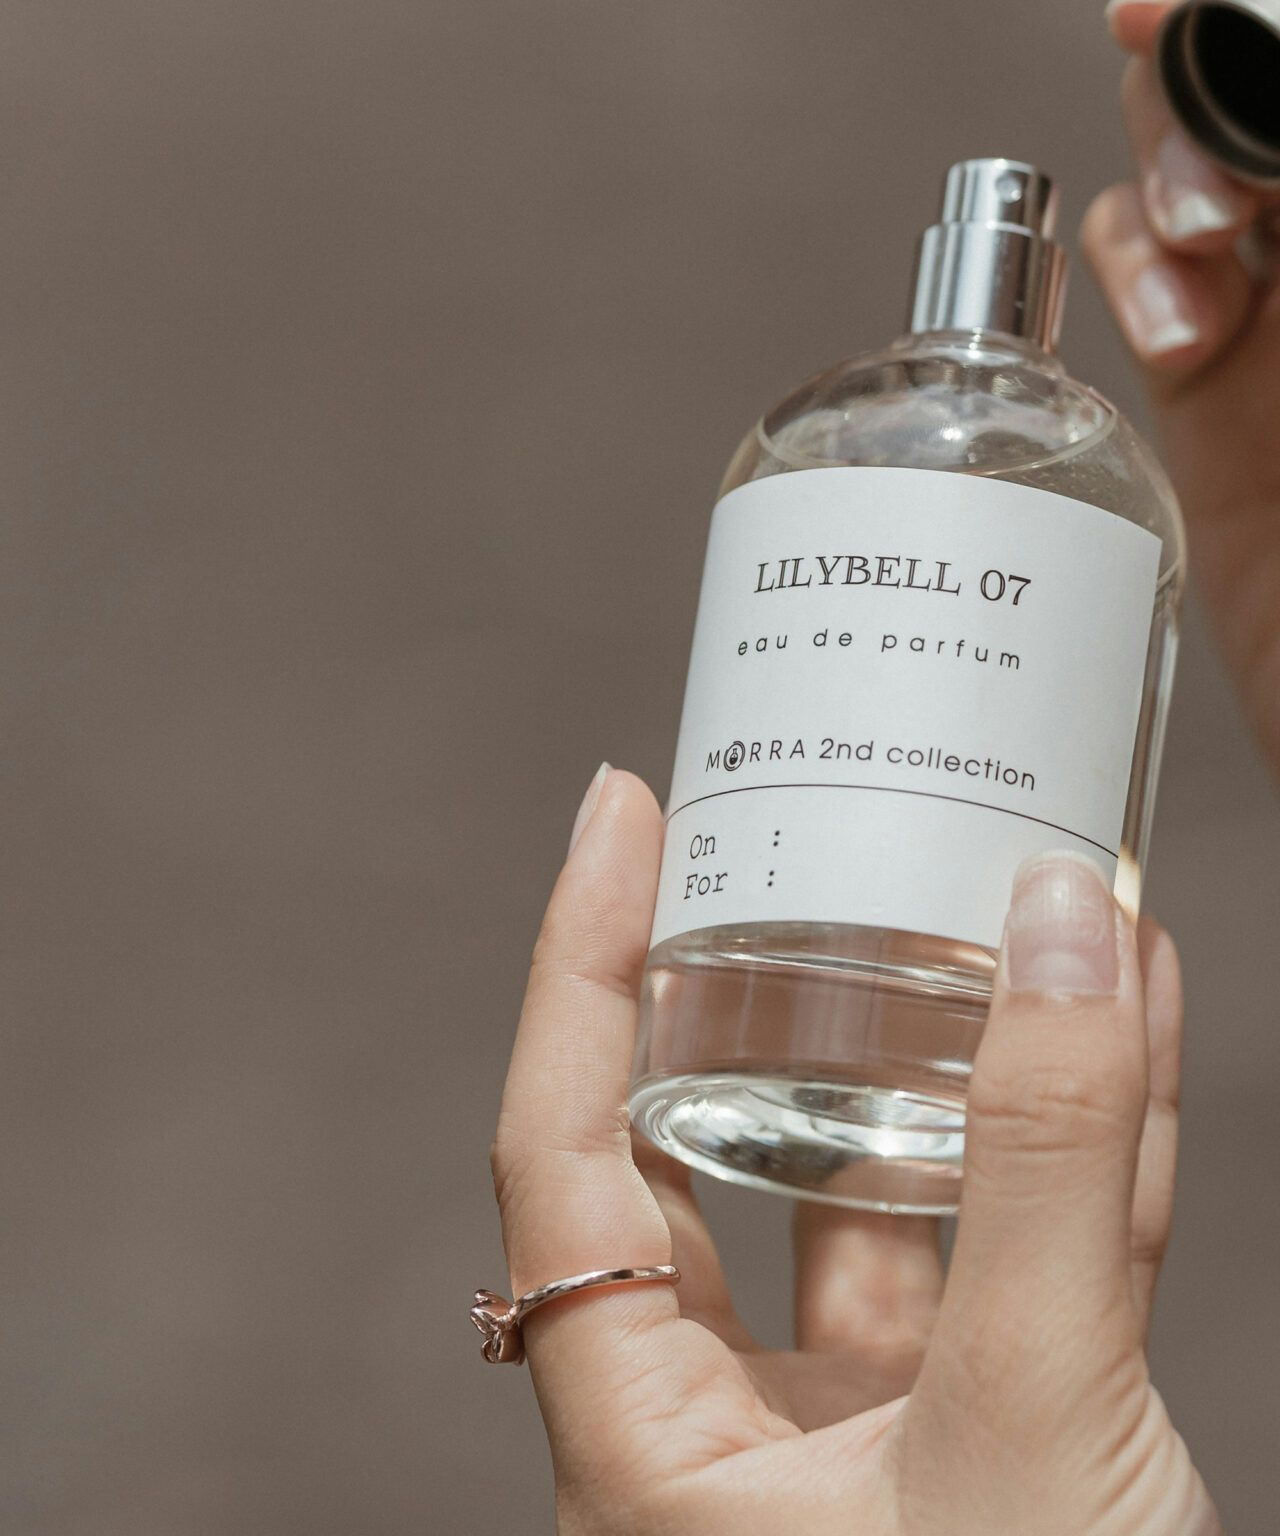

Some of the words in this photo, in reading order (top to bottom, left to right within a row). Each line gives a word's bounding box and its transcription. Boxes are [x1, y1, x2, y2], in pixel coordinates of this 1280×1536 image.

[753, 554, 962, 597] LILYBELL
[979, 569, 1032, 607] 07
[737, 633, 788, 657] eau
[812, 628, 853, 648] de
[880, 633, 1020, 671] parfum
[705, 738, 806, 773] MORRA
[818, 737, 875, 762] 2nd
[886, 744, 1036, 792] collection
[689, 833, 717, 860] On
[683, 870, 729, 901] For
